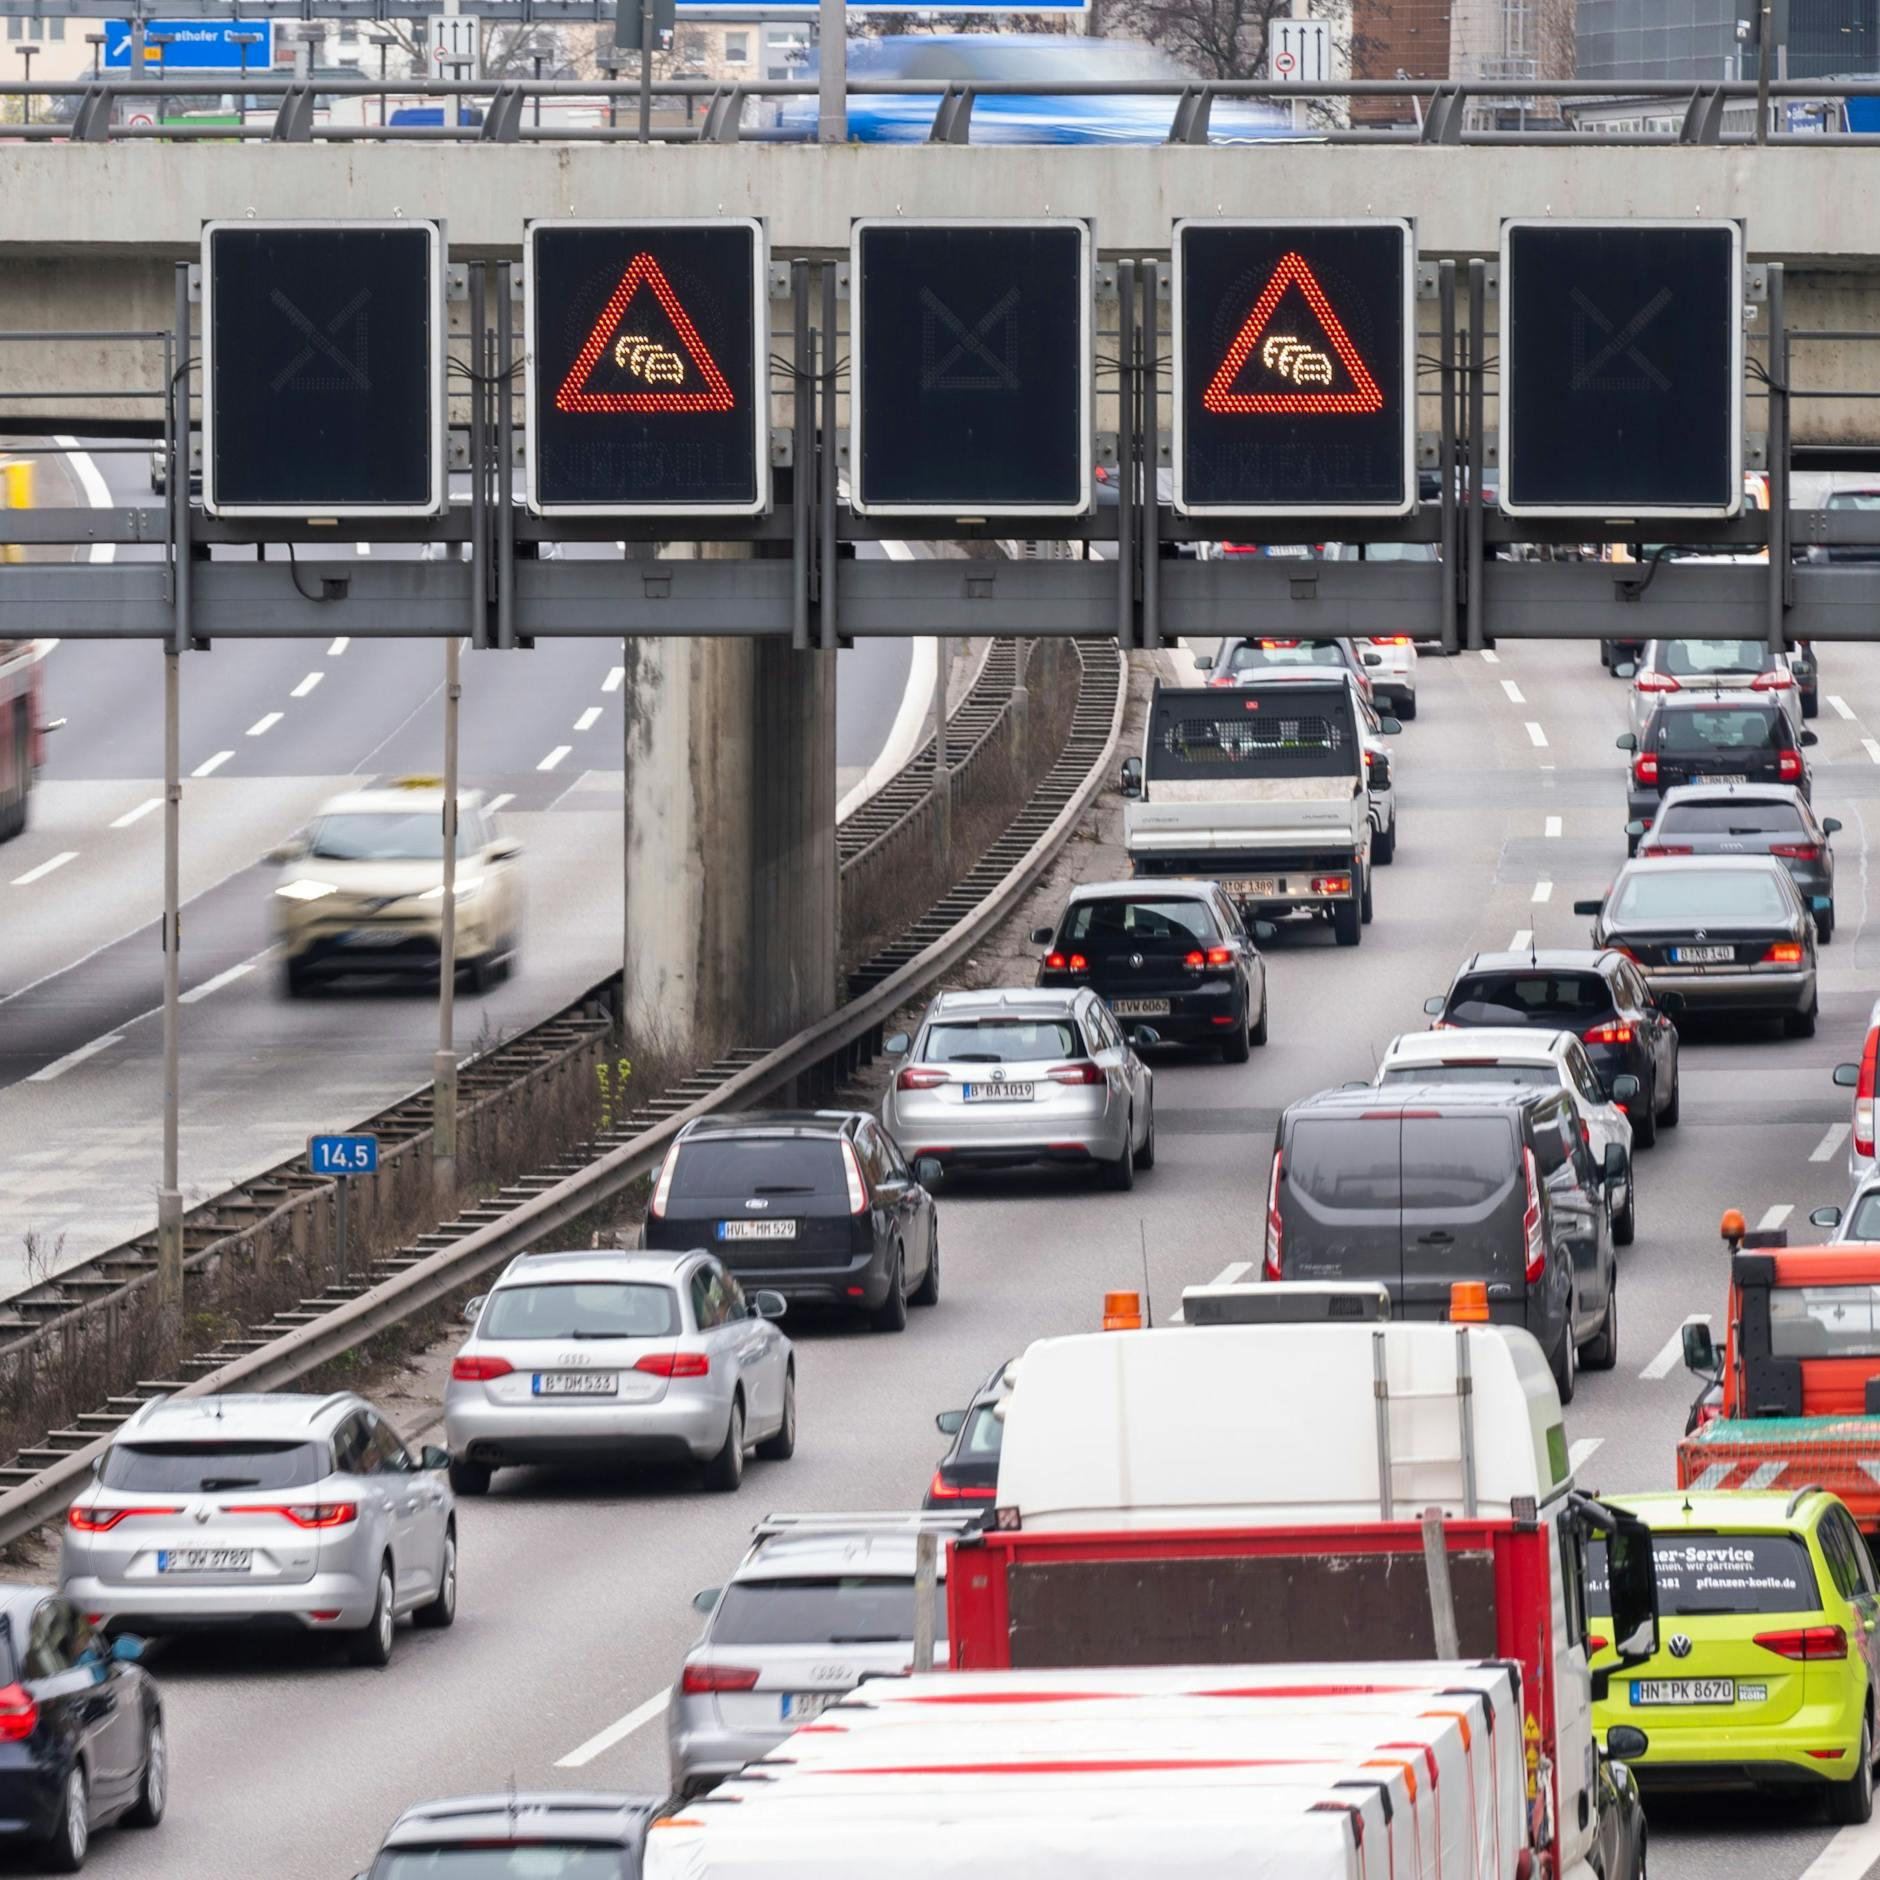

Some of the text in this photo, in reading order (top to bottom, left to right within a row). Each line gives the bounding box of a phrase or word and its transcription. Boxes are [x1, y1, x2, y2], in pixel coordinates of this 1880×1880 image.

[971, 1082, 1032, 1097] B BA 1019
[320, 1143, 369, 1168] 14.5
[726, 1222, 748, 1236] HVL
[773, 1222, 794, 1235] 529
[546, 1375, 554, 1391] B
[1653, 1546, 1755, 1563] er-Service
[1685, 1562, 1705, 1572] wir
[1641, 1681, 1732, 1700] HN PK 8670
